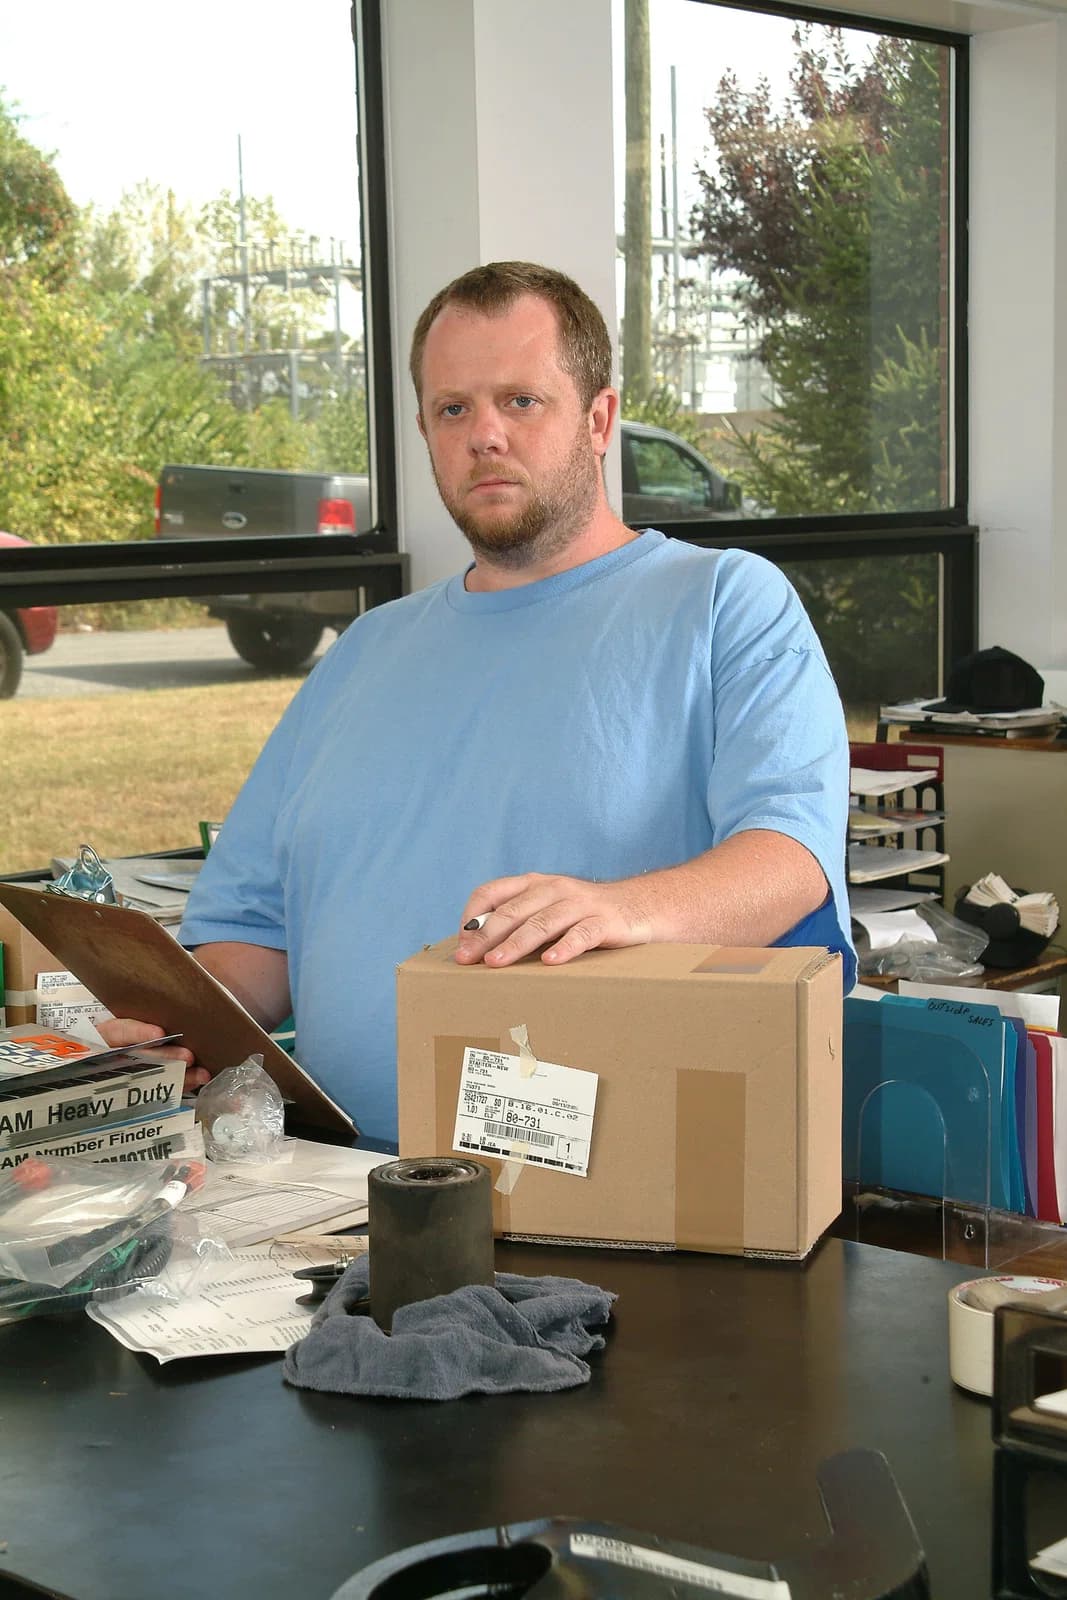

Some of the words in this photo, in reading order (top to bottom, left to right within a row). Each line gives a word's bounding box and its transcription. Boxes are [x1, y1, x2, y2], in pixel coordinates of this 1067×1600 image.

[48, 1096, 114, 1125] Heavy
[127, 1082, 175, 1107] Duty
[505, 1112, 541, 1129] 80-731
[109, 1125, 163, 1146] Finder
